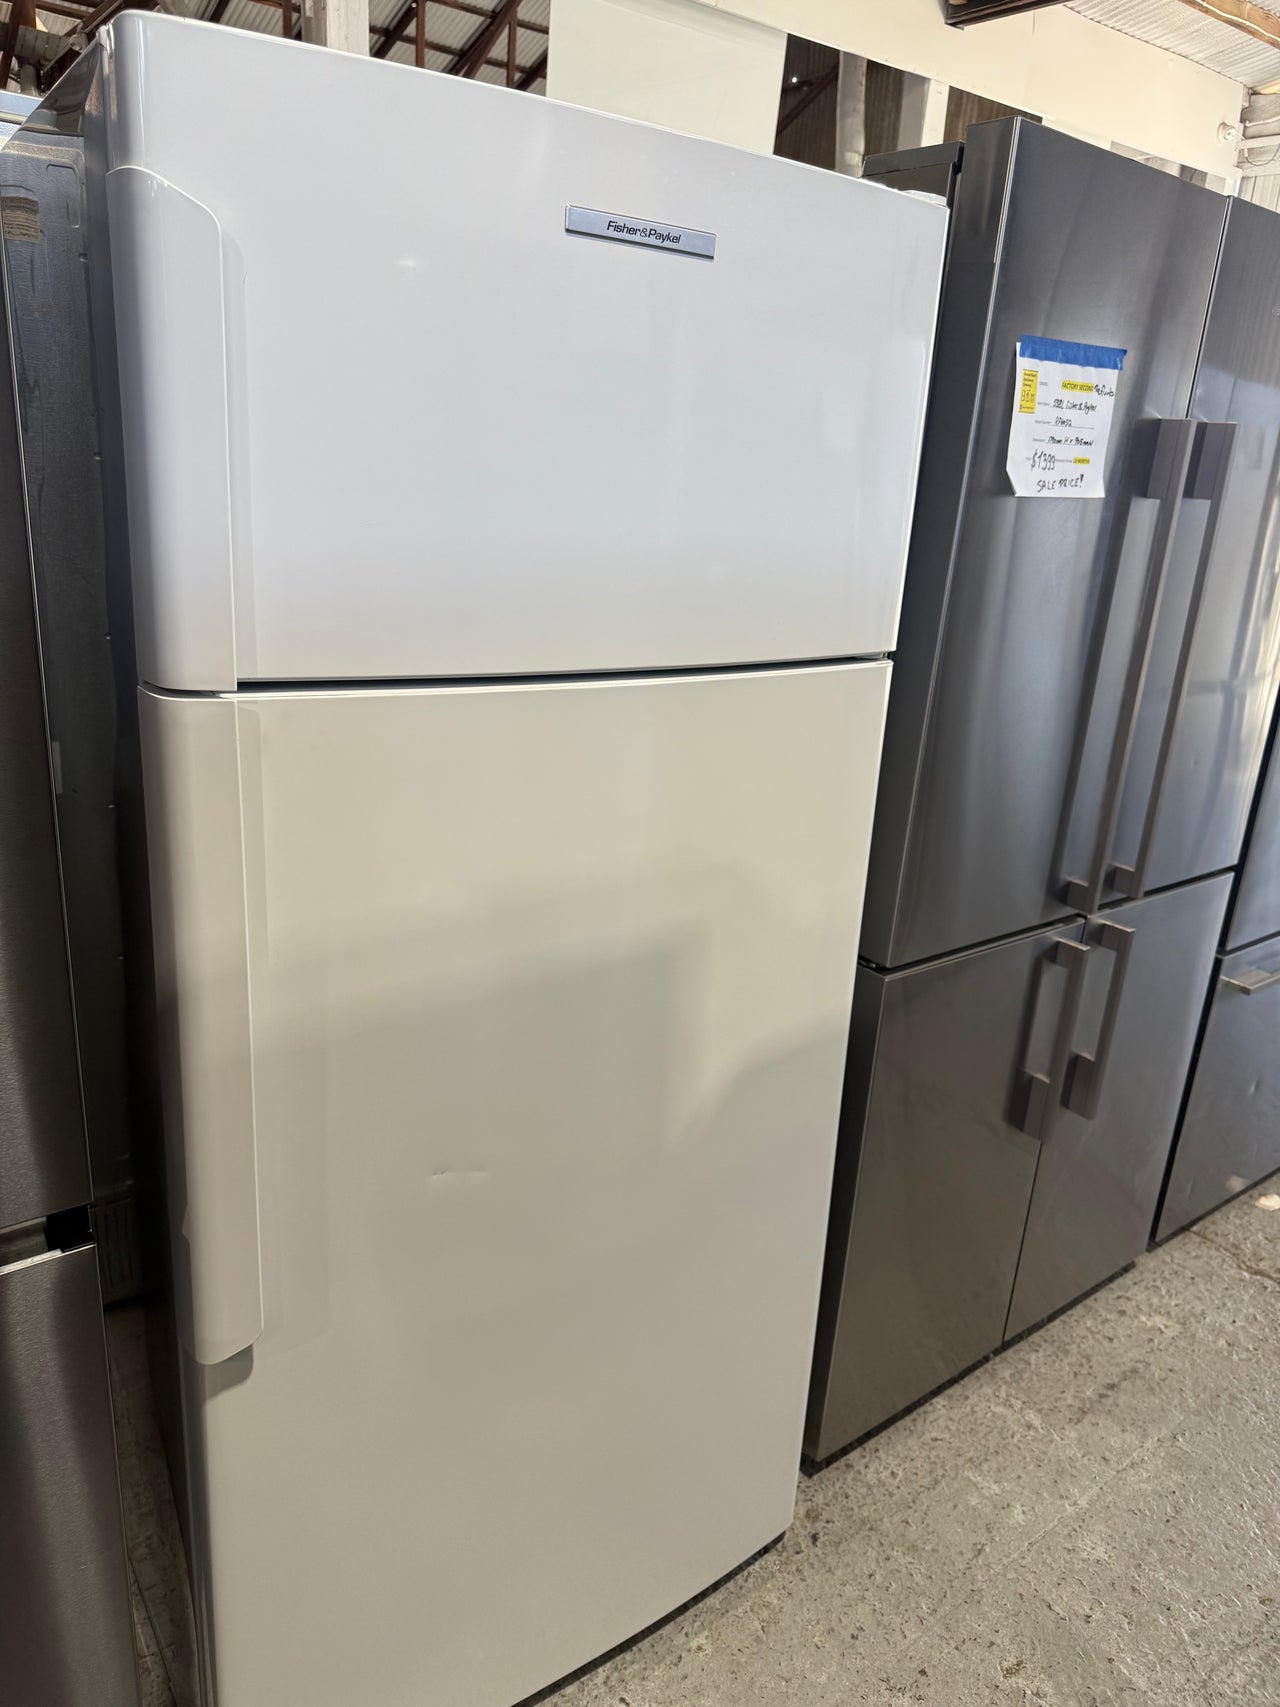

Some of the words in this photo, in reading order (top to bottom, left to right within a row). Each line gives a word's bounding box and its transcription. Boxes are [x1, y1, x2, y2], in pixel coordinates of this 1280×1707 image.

[606, 220, 682, 244] Fisher&Paykel
[1062, 382, 1078, 390] FACTORY
[1079, 384, 1093, 392] SECOND
[1037, 479, 1056, 493] SALE
[1058, 474, 1085, 489] PRICE!
